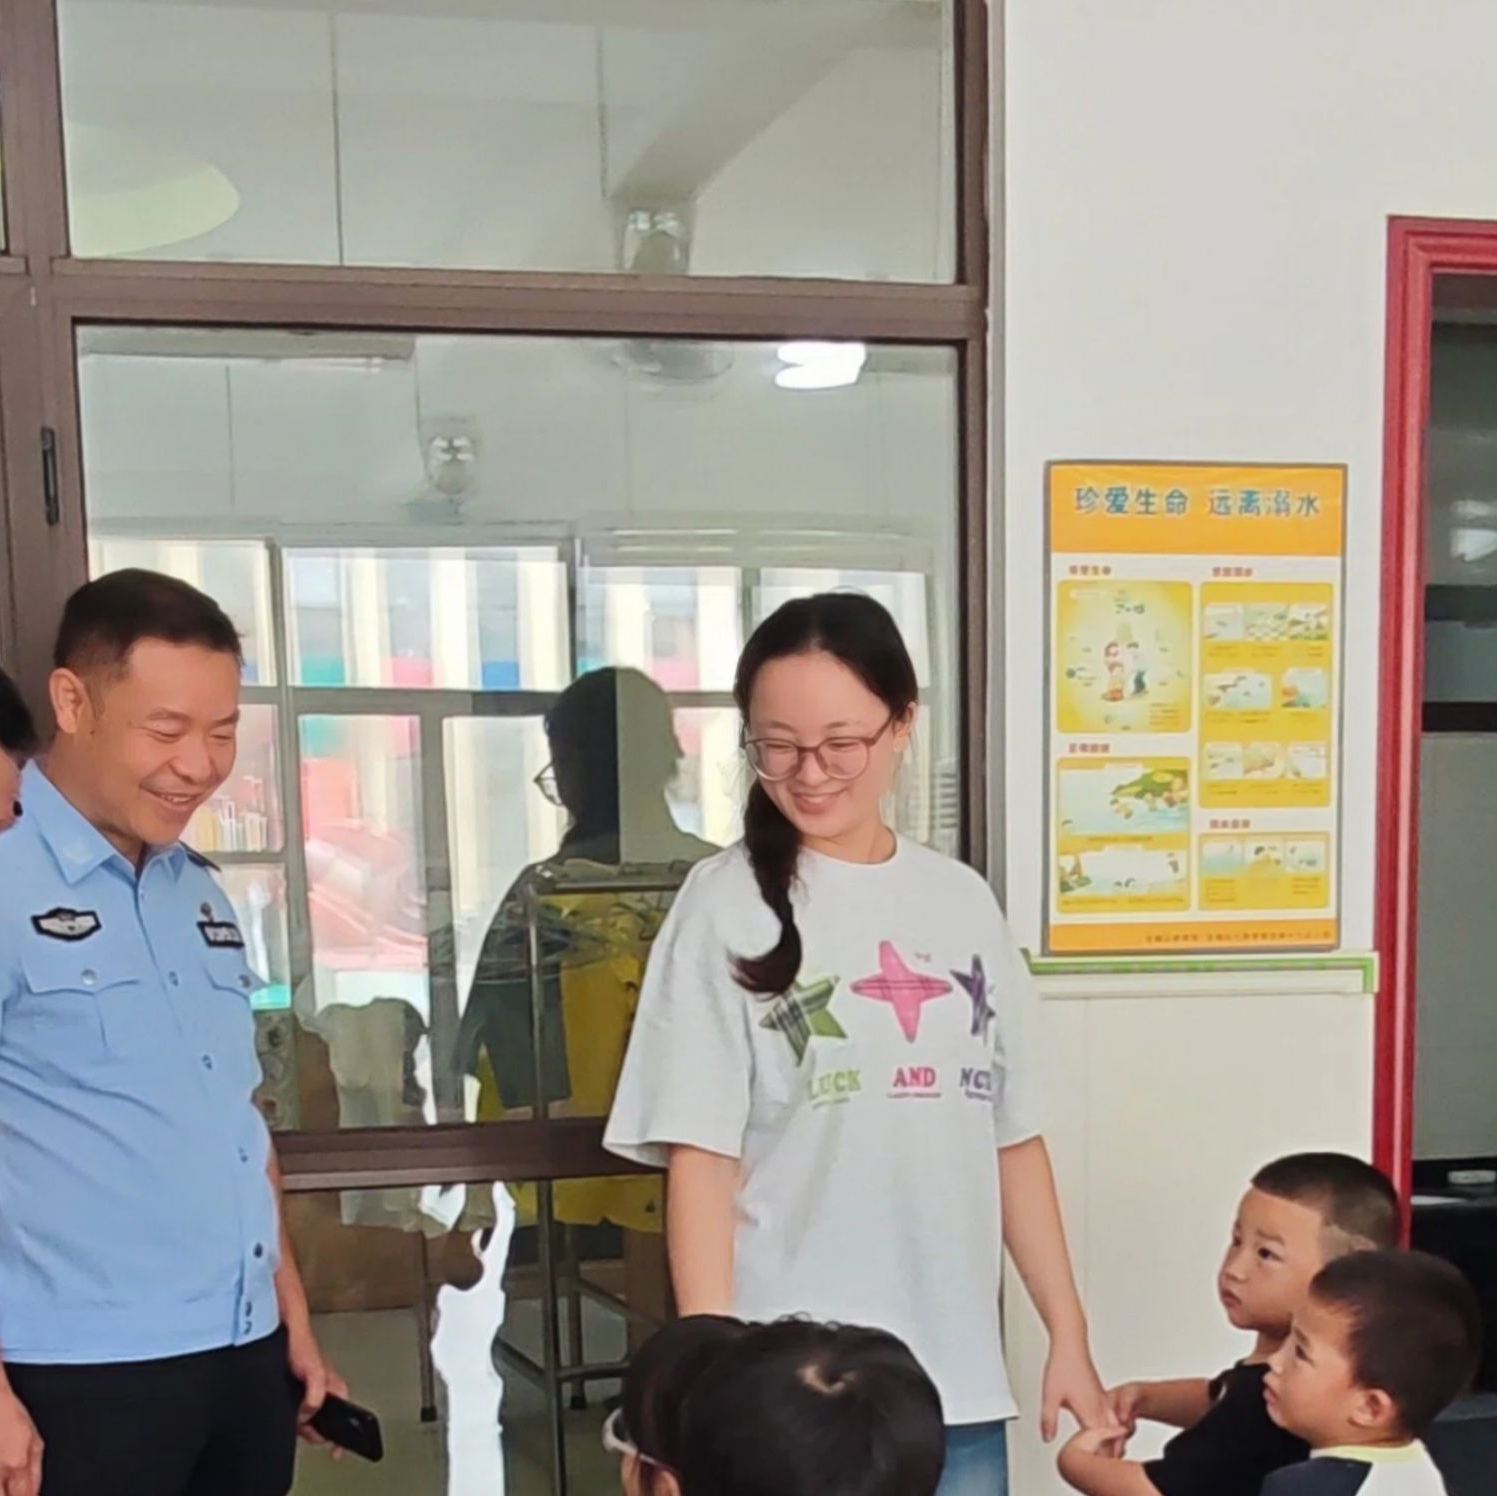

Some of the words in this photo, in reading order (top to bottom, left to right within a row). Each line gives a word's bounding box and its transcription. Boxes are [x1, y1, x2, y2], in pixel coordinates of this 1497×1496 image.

[1073, 484, 1190, 516] 珍爱生命
[1206, 488, 1321, 518] 远离溺水
[806, 1069, 863, 1101] LUCK
[892, 1065, 937, 1089] AND
